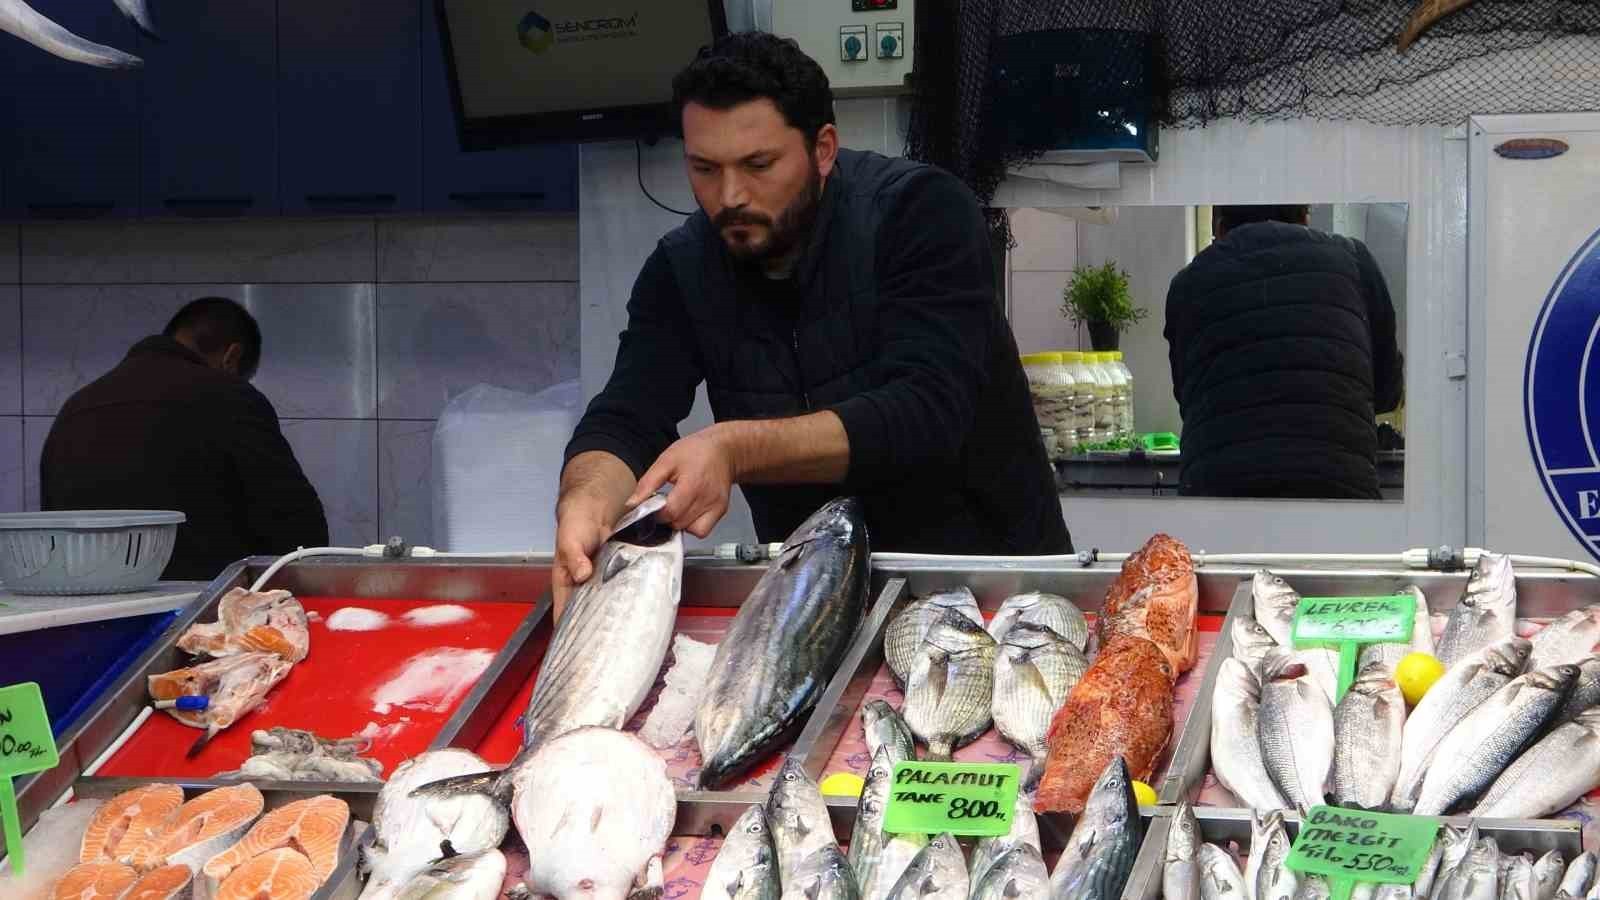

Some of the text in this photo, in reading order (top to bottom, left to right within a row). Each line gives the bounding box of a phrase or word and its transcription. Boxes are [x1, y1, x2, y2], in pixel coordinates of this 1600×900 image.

[1303, 602, 1400, 616] LEVREK
[896, 768, 1010, 788] PALAMUT
[894, 792, 944, 803] TANE
[1310, 811, 1378, 829] BAKO
